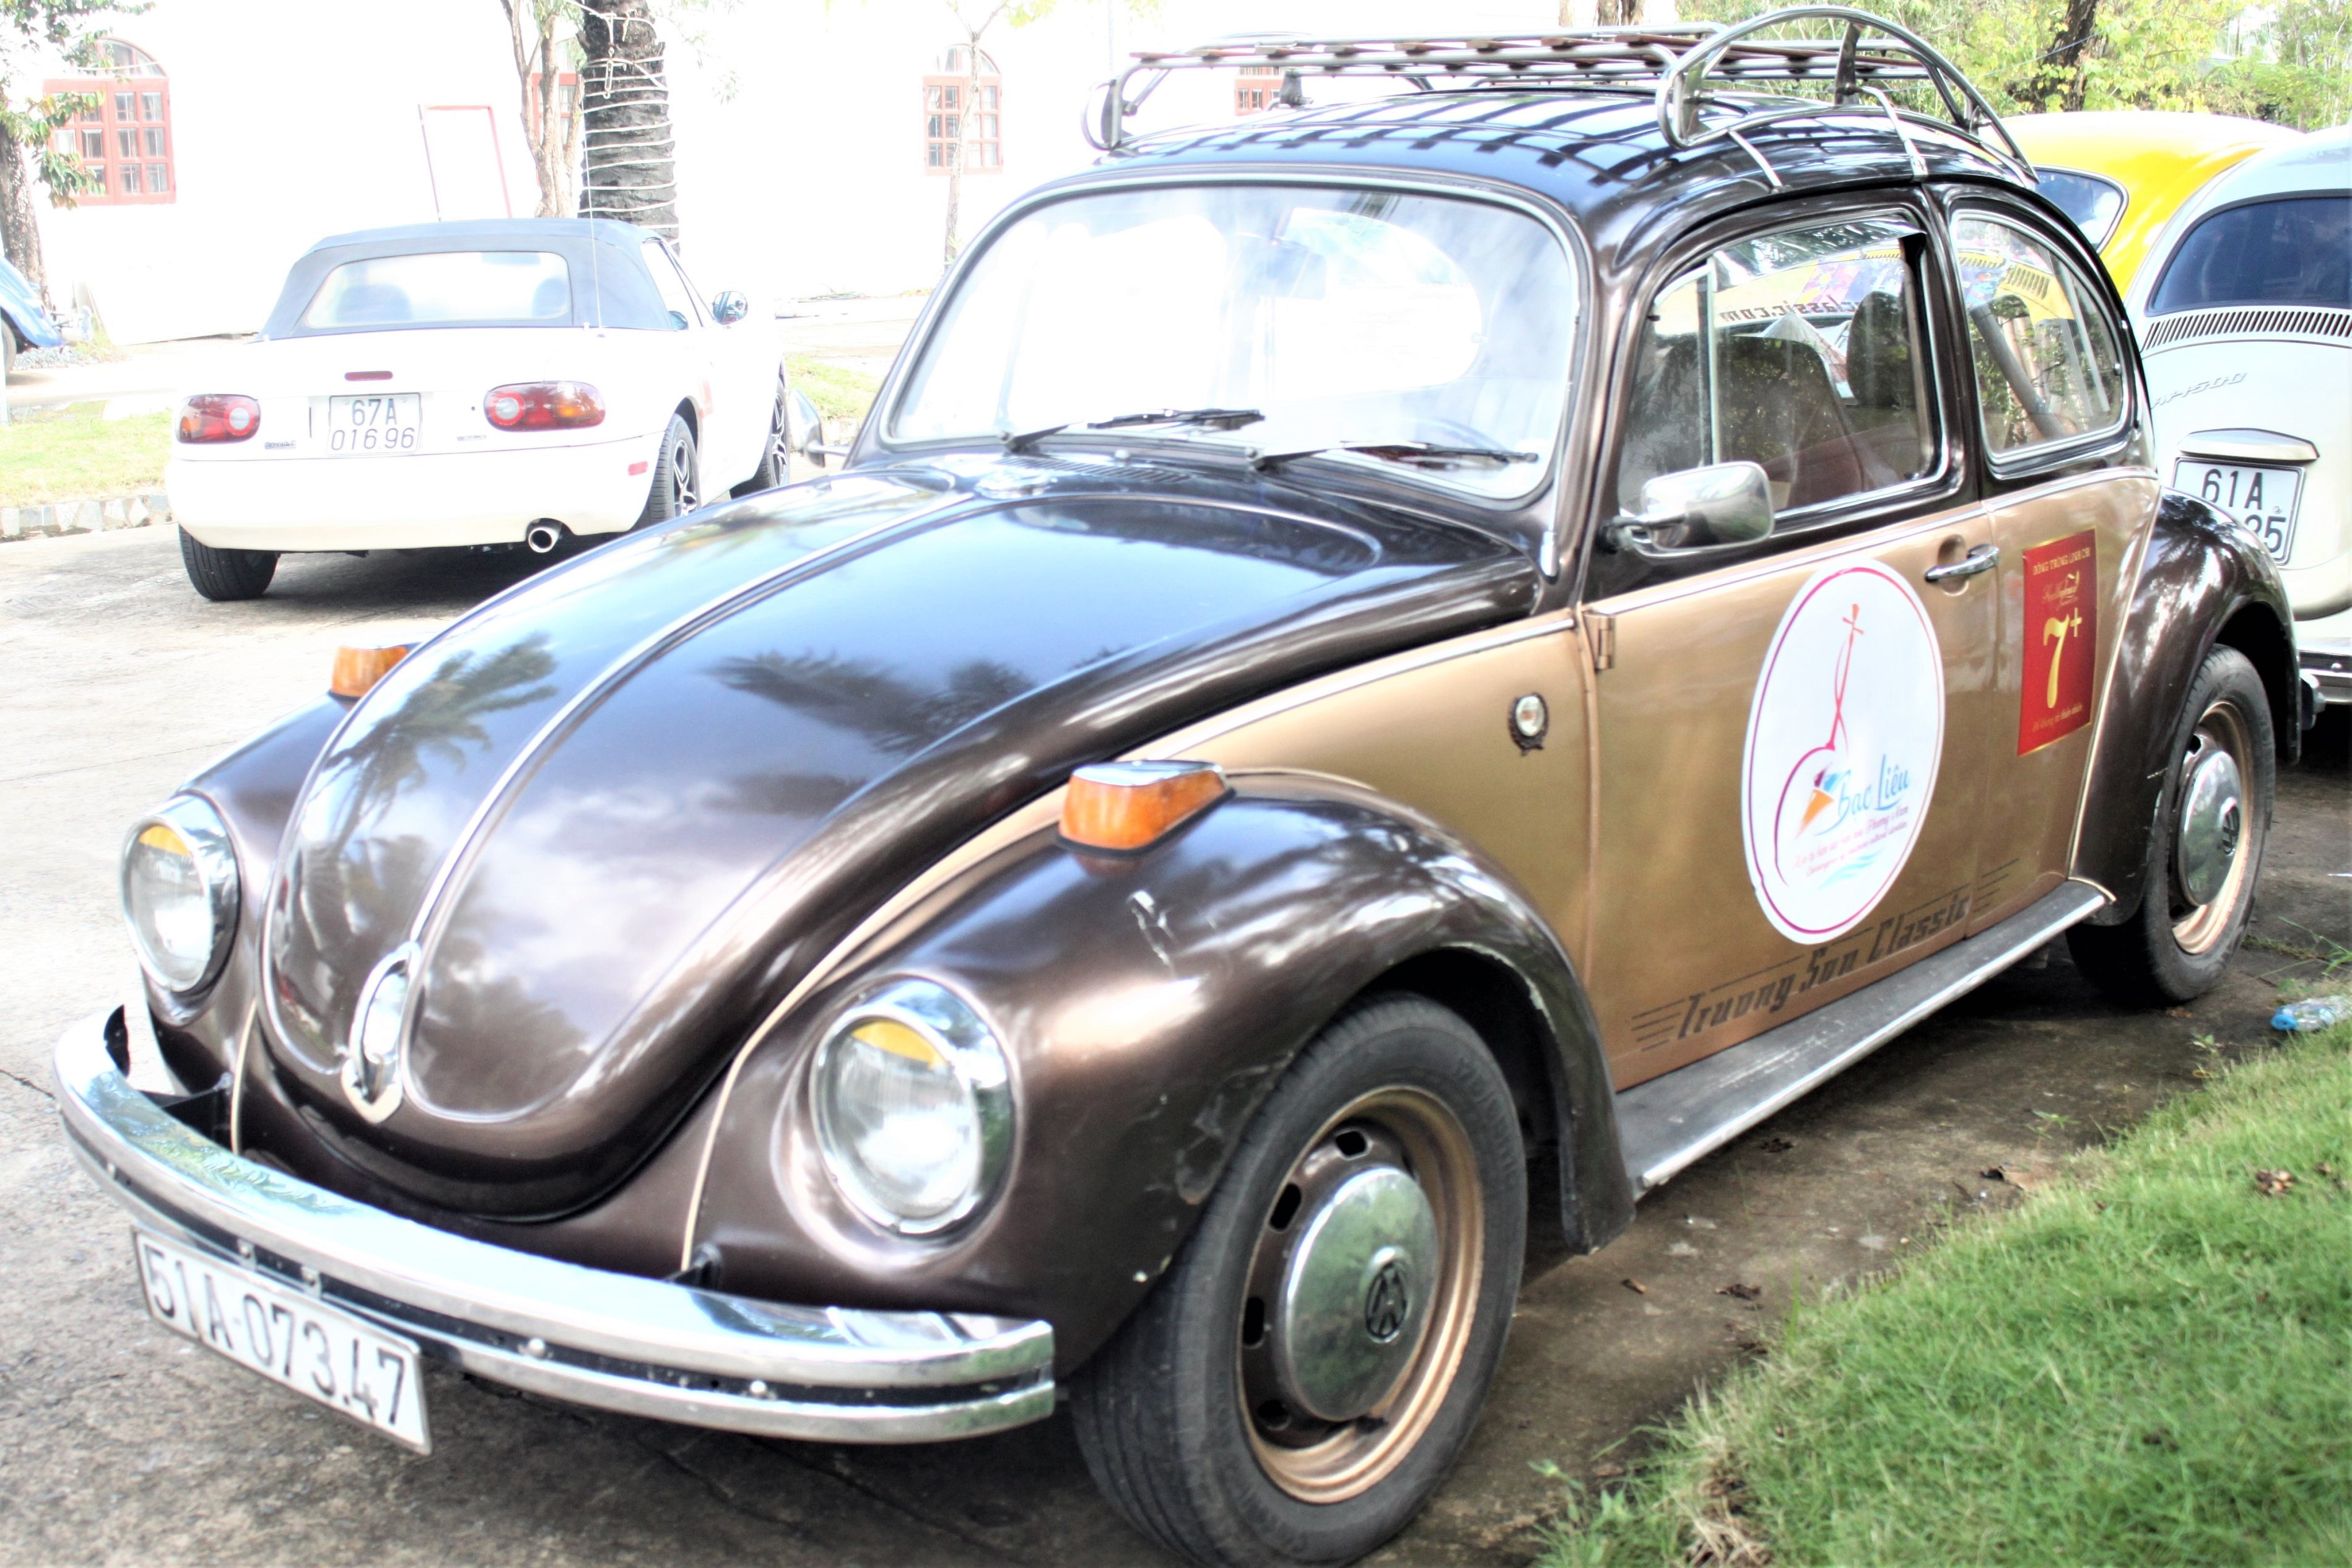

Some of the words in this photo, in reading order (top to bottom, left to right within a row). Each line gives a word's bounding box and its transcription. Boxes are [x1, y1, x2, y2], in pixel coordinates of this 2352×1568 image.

[352, 398, 398, 426] 67A
[2202, 468, 2263, 510] 61A
[1874, 754, 1909, 812] Liêu
[1867, 894, 1971, 963] Classic
